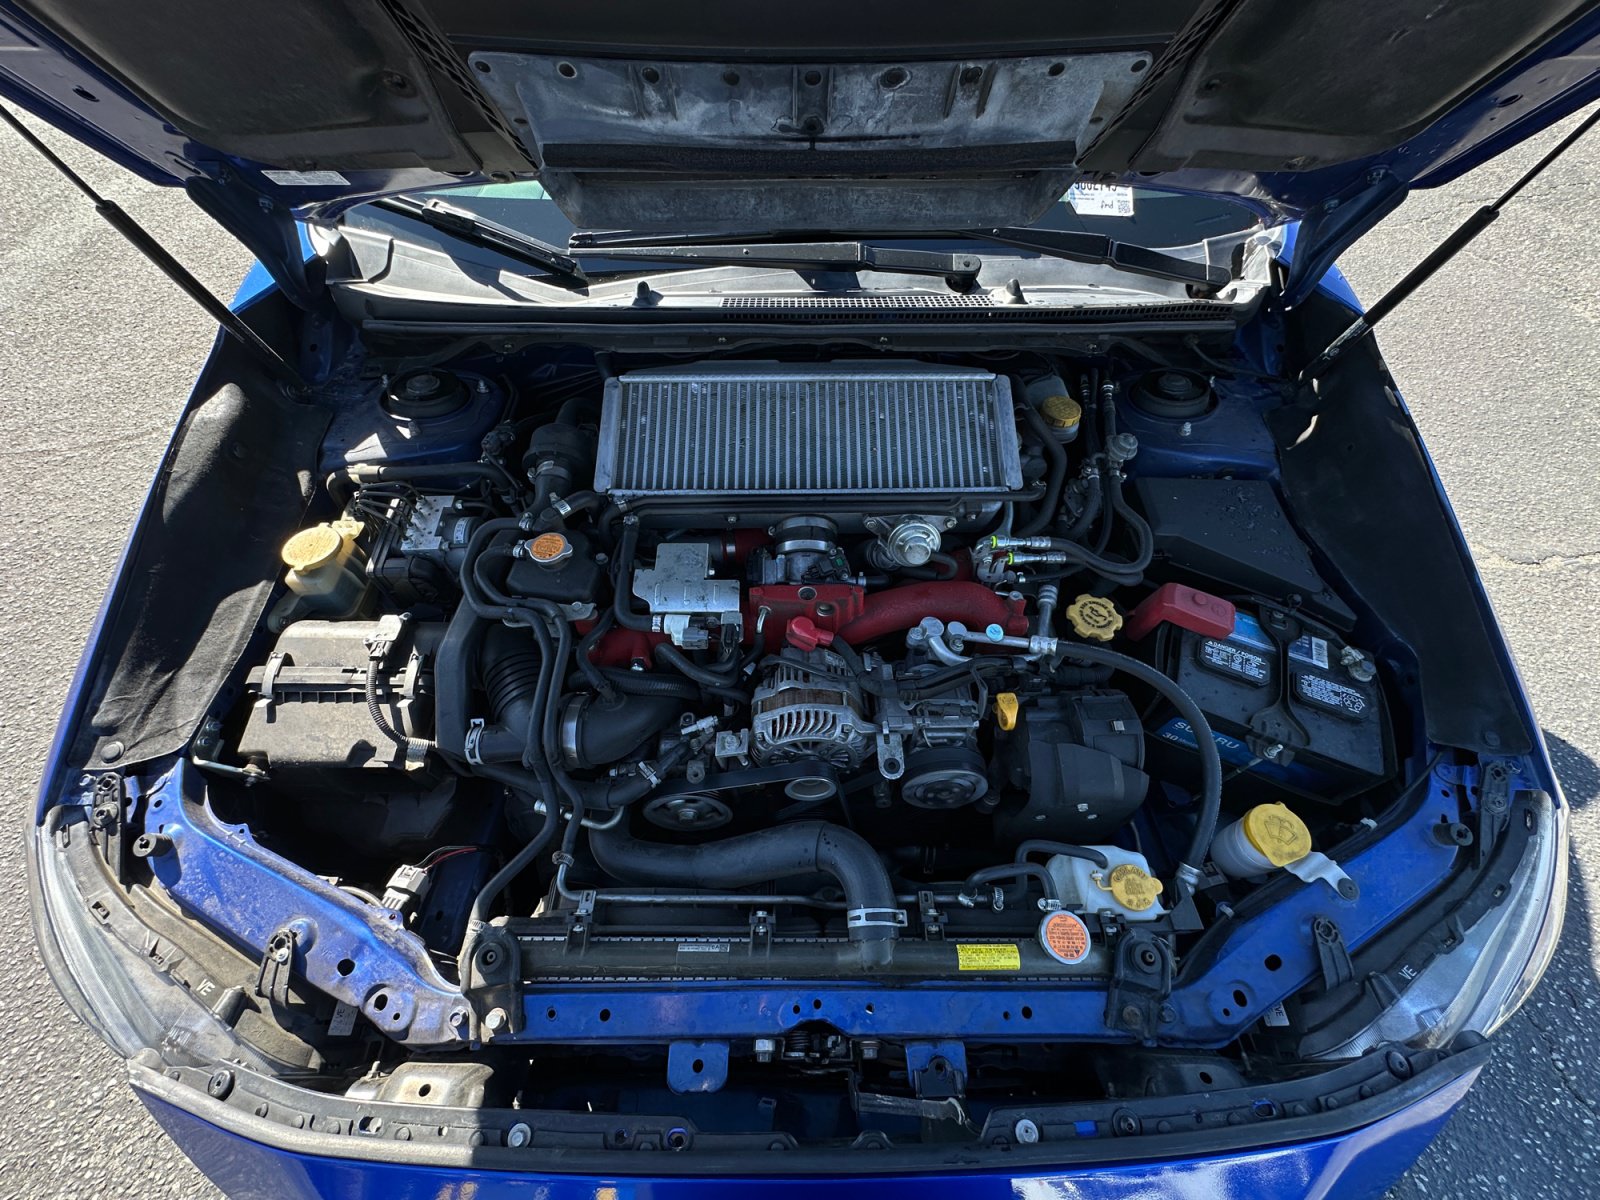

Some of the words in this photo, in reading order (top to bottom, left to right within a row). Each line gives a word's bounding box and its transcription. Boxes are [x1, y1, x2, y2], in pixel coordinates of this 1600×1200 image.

[1162, 732, 1179, 741] 30
[1174, 721, 1240, 749] SURU
[1398, 964, 1418, 980] VE
[196, 978, 216, 996] VE
